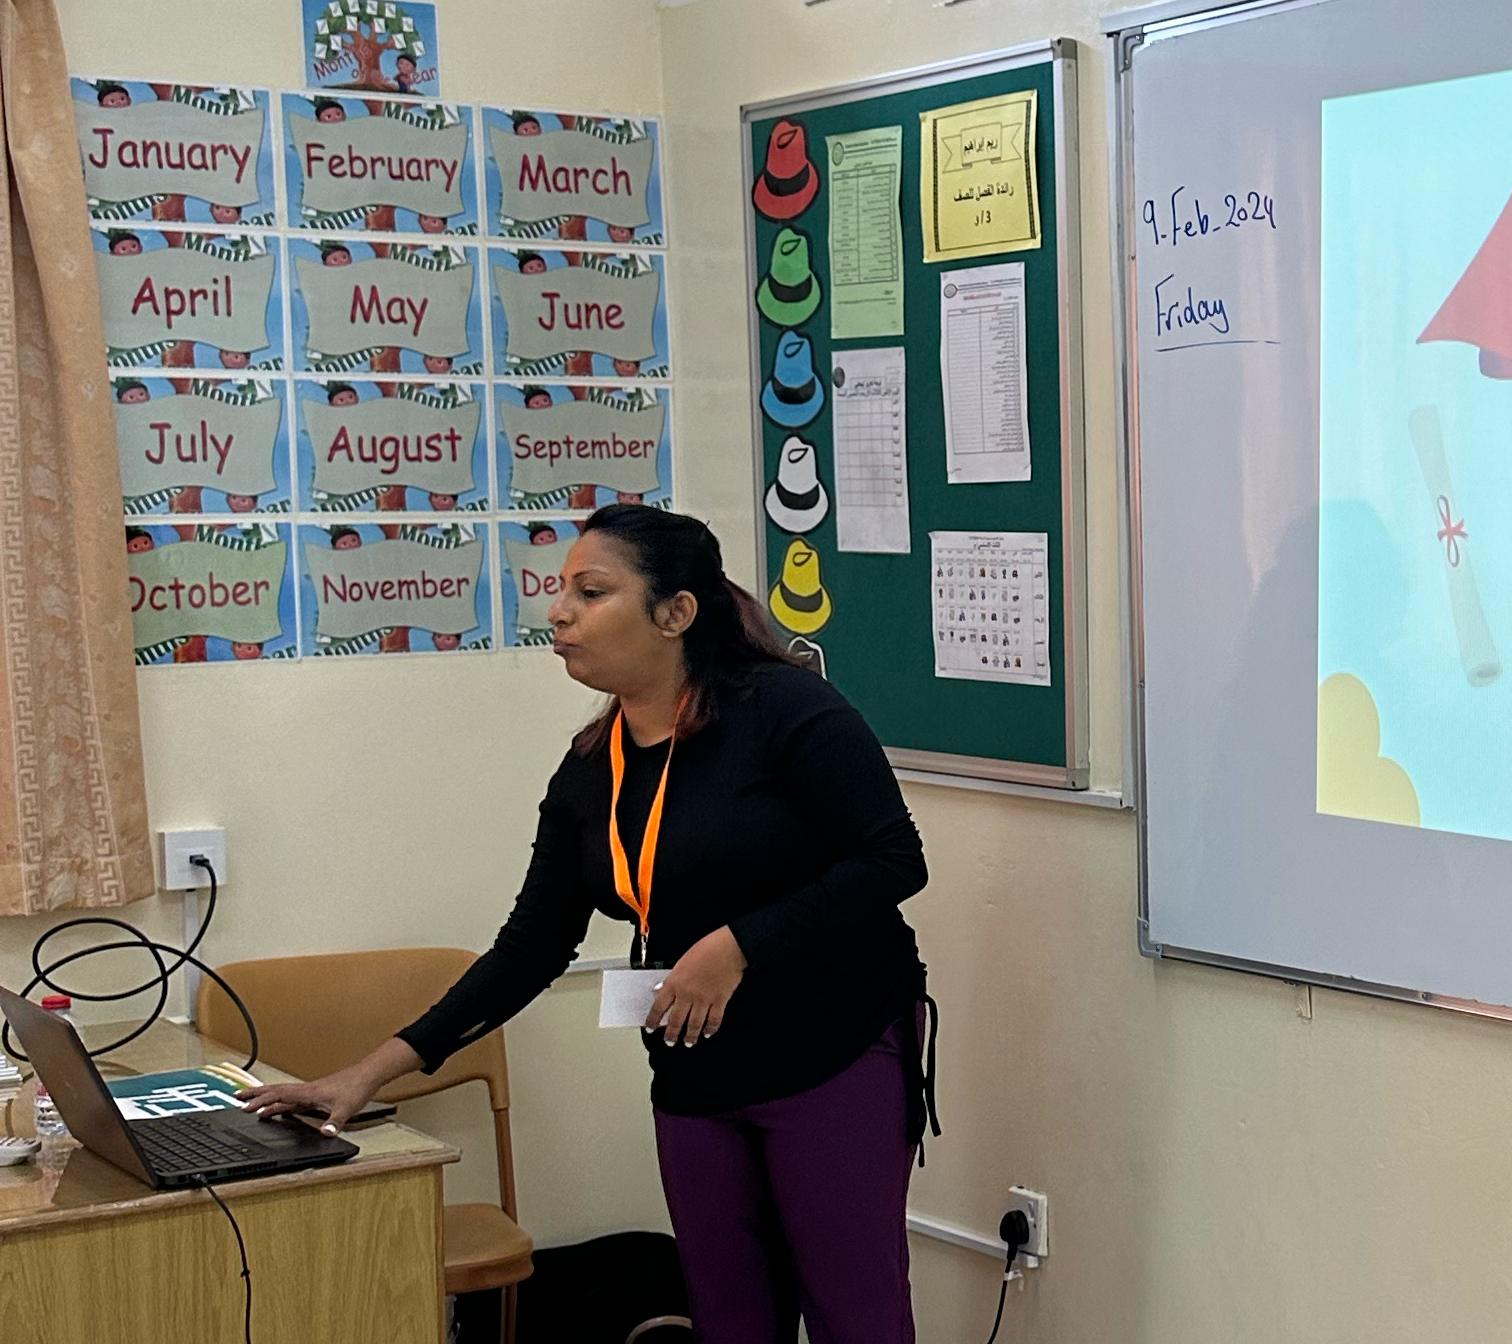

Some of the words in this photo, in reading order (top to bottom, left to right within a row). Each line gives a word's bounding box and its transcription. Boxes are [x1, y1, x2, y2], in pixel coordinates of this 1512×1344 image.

[410, 67, 437, 84] ear
[88, 128, 252, 184] January
[305, 142, 458, 193] February
[519, 154, 632, 197] March
[131, 276, 232, 330] April
[350, 284, 428, 337] May
[538, 292, 625, 331] June
[1155, 274, 1230, 337] Friday
[145, 420, 234, 476] July
[327, 426, 463, 475] August
[514, 433, 655, 467] September
[323, 570, 470, 604] November
